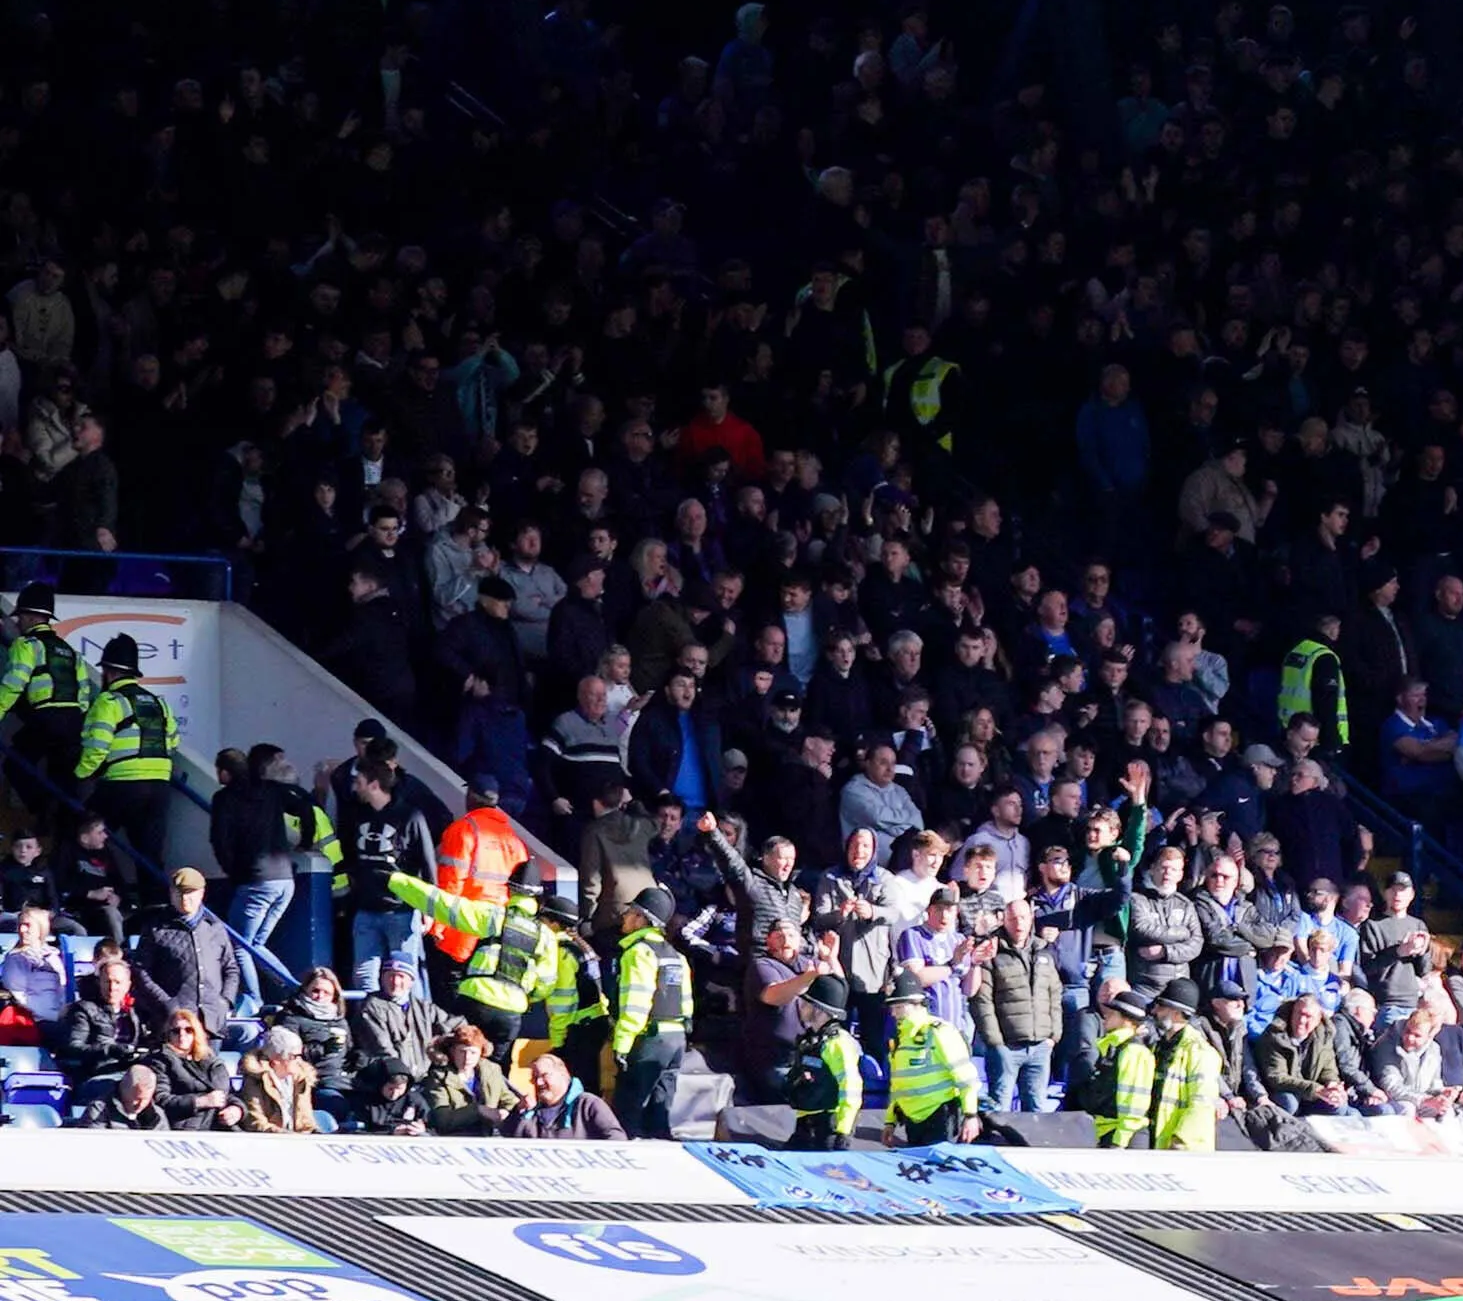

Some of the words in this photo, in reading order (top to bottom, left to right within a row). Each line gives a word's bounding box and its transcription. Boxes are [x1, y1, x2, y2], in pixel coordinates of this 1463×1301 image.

[145, 1139, 229, 1161] OMA
[321, 1143, 456, 1166] IPSWICH
[470, 1146, 648, 1170] MORTGAGE
[163, 1166, 273, 1190] GROUP
[457, 1173, 592, 1196] CENTRE
[1026, 1170, 1197, 1192] UMARIDGE
[540, 1233, 682, 1261] fis
